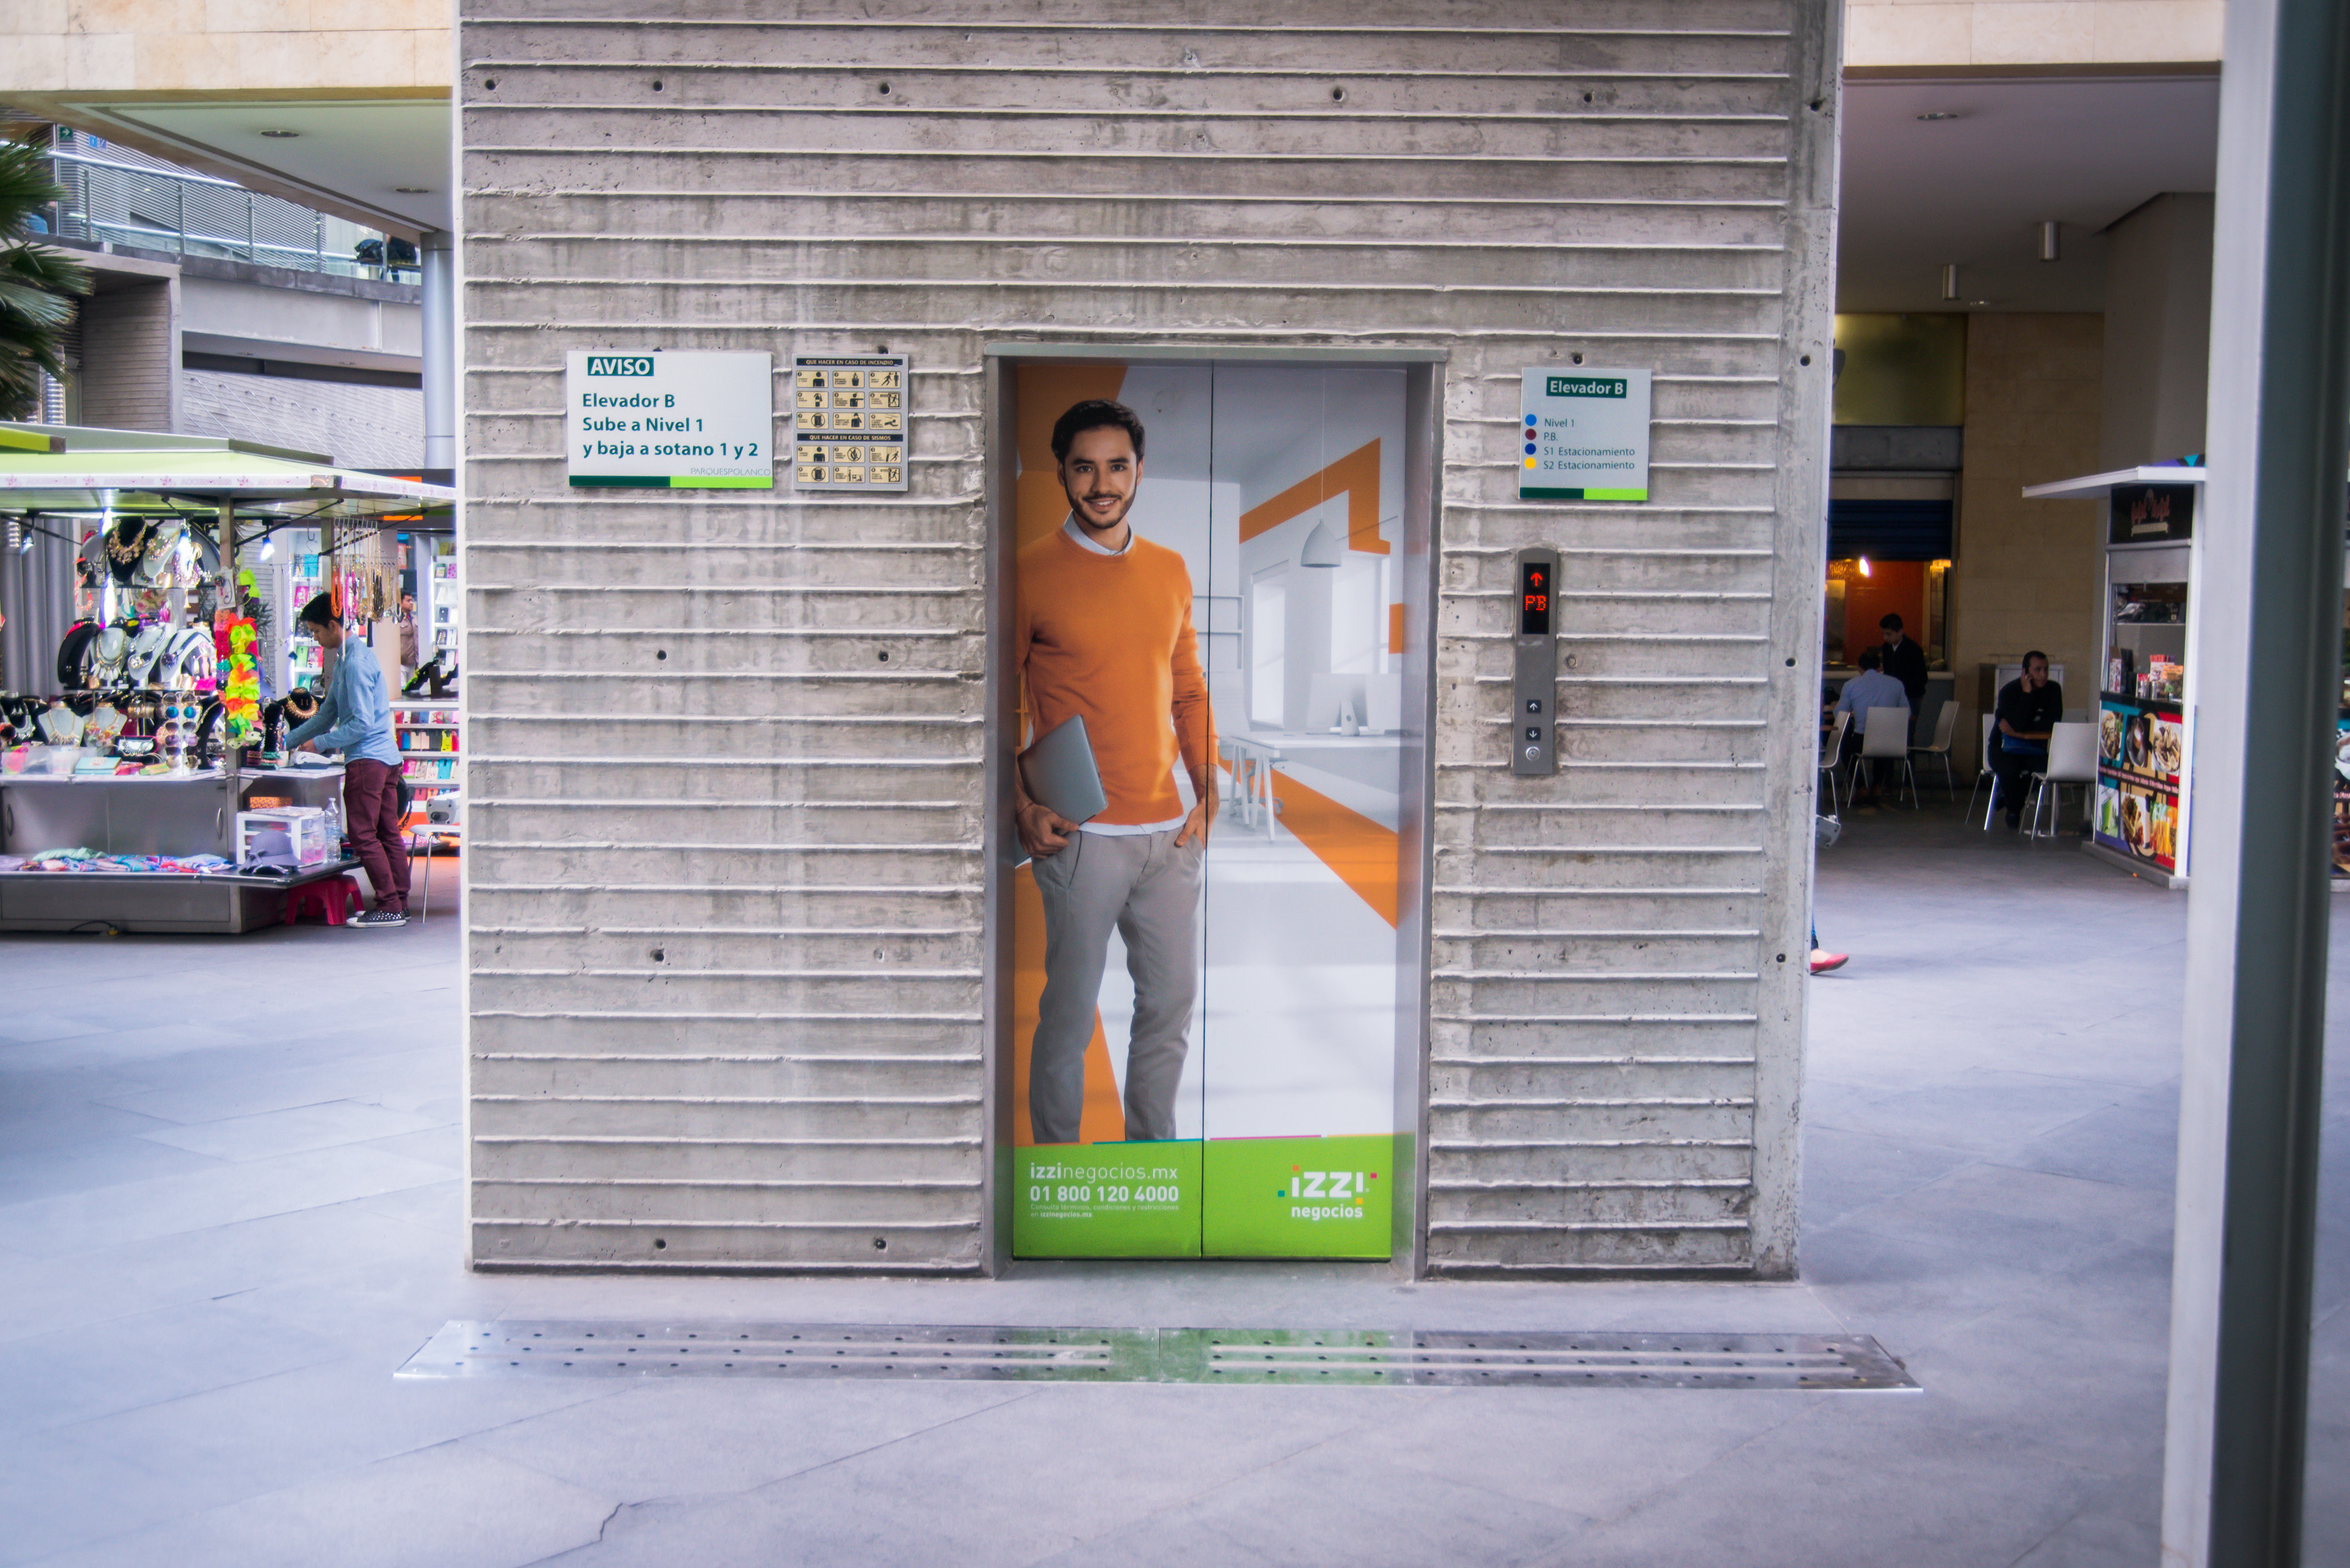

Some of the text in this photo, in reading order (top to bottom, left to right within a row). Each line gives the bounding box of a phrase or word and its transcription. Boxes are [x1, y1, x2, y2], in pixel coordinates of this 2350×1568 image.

[590, 358, 650, 375] AVISO
[1549, 380, 1624, 396] Elevador B
[583, 392, 675, 408] Elevador B
[582, 417, 703, 432] Sube a Nivel 1
[1544, 417, 1575, 428] Nivel 1
[1543, 432, 1558, 442] P.B.
[583, 440, 759, 461] y baja a sotano 1 y 2
[1543, 446, 1636, 457] S1 Estacionamiento
[690, 468, 771, 477] PARQUESPOLANCO
[1543, 461, 1636, 470] S2 Estacionamiento
[1524, 594, 1547, 611] PB
[1030, 1162, 1178, 1184] izzinegocios.mx
[1030, 1185, 1180, 1202] 01 800 120 4000
[1291, 1204, 1364, 1222] negocios
